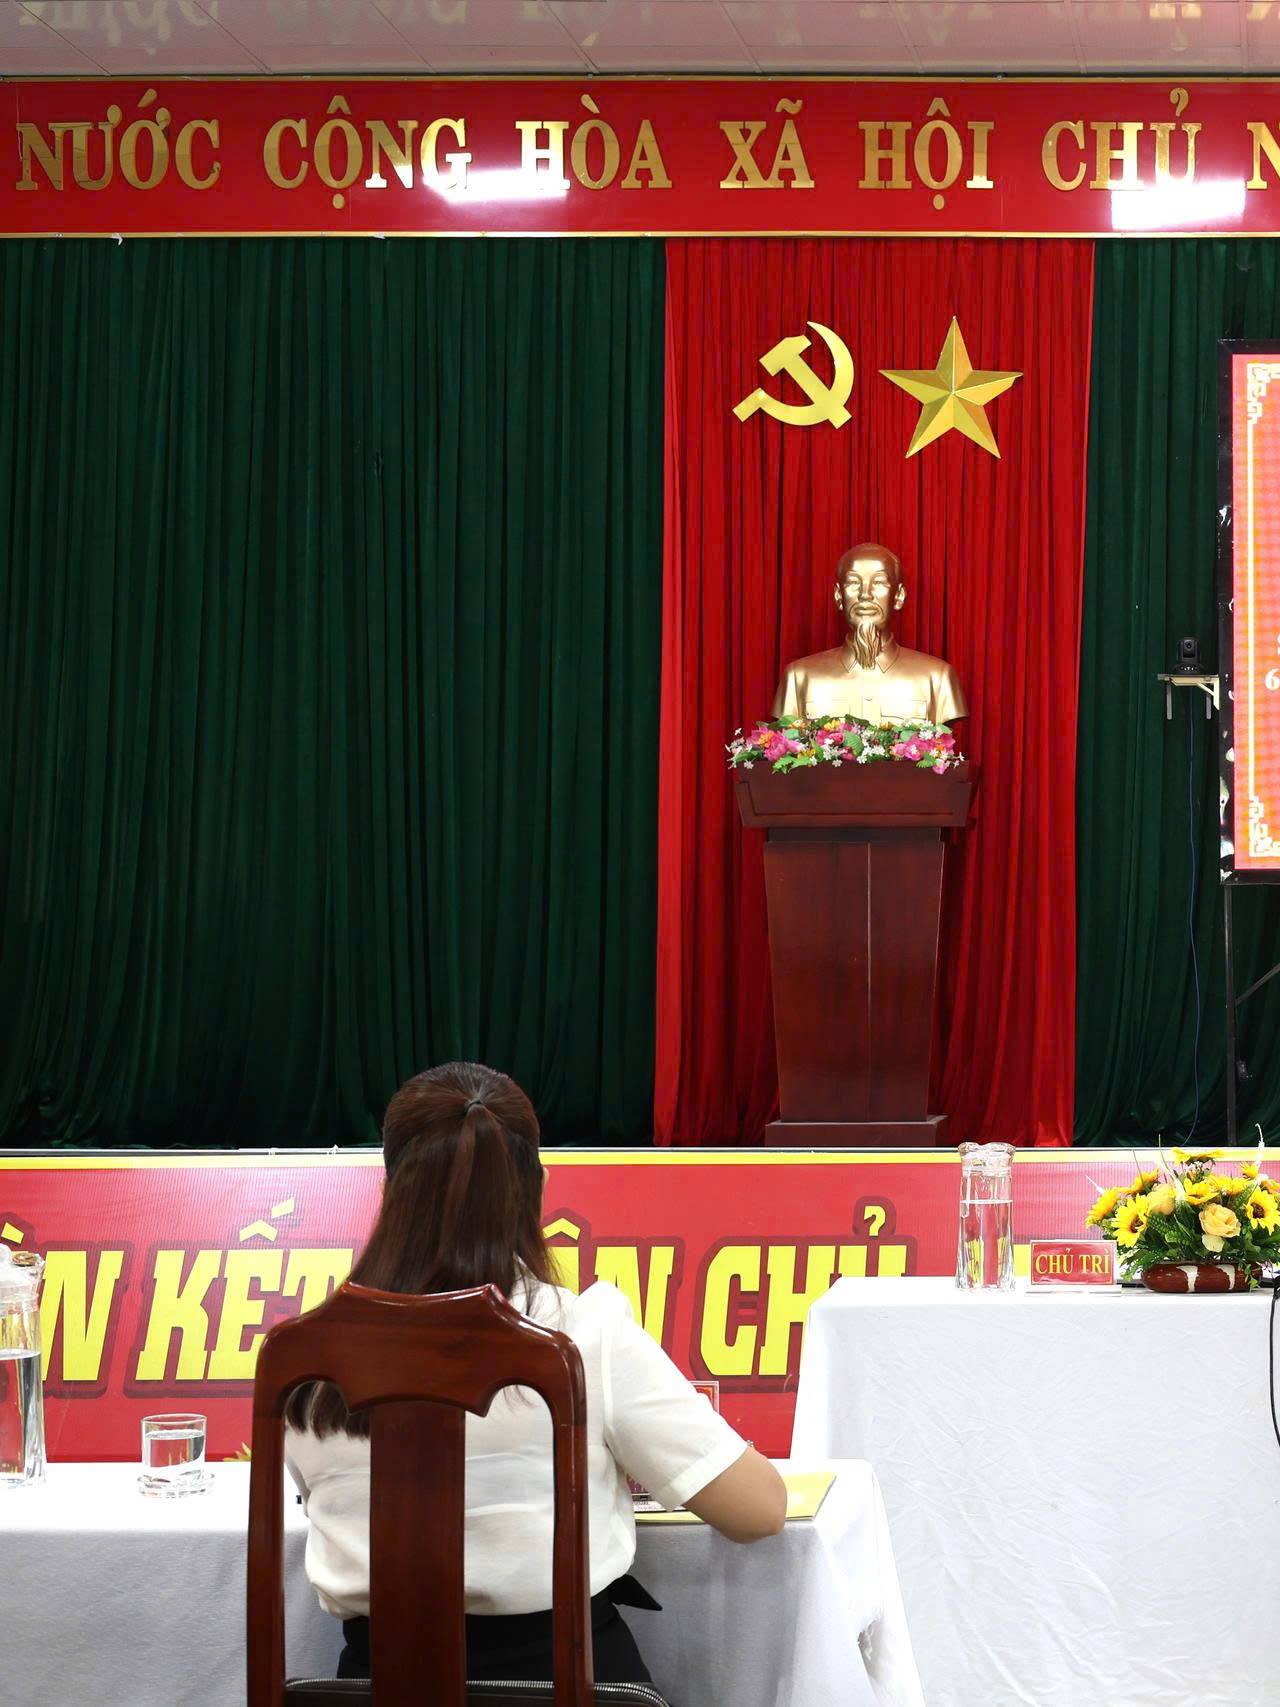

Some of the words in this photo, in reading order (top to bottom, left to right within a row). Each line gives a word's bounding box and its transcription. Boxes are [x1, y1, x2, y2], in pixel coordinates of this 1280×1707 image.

[16, 89, 221, 191] NƯỚC
[263, 95, 472, 209] CỘNG
[516, 94, 673, 191] HÒA
[719, 98, 815, 190] XÃ
[858, 97, 994, 210] HỘI
[1041, 88, 1202, 191] CHỦ
[1265, 668, 1280, 690] 6
[1035, 1248, 1075, 1274] CHỦ
[1078, 1248, 1110, 1274] TRÌ
